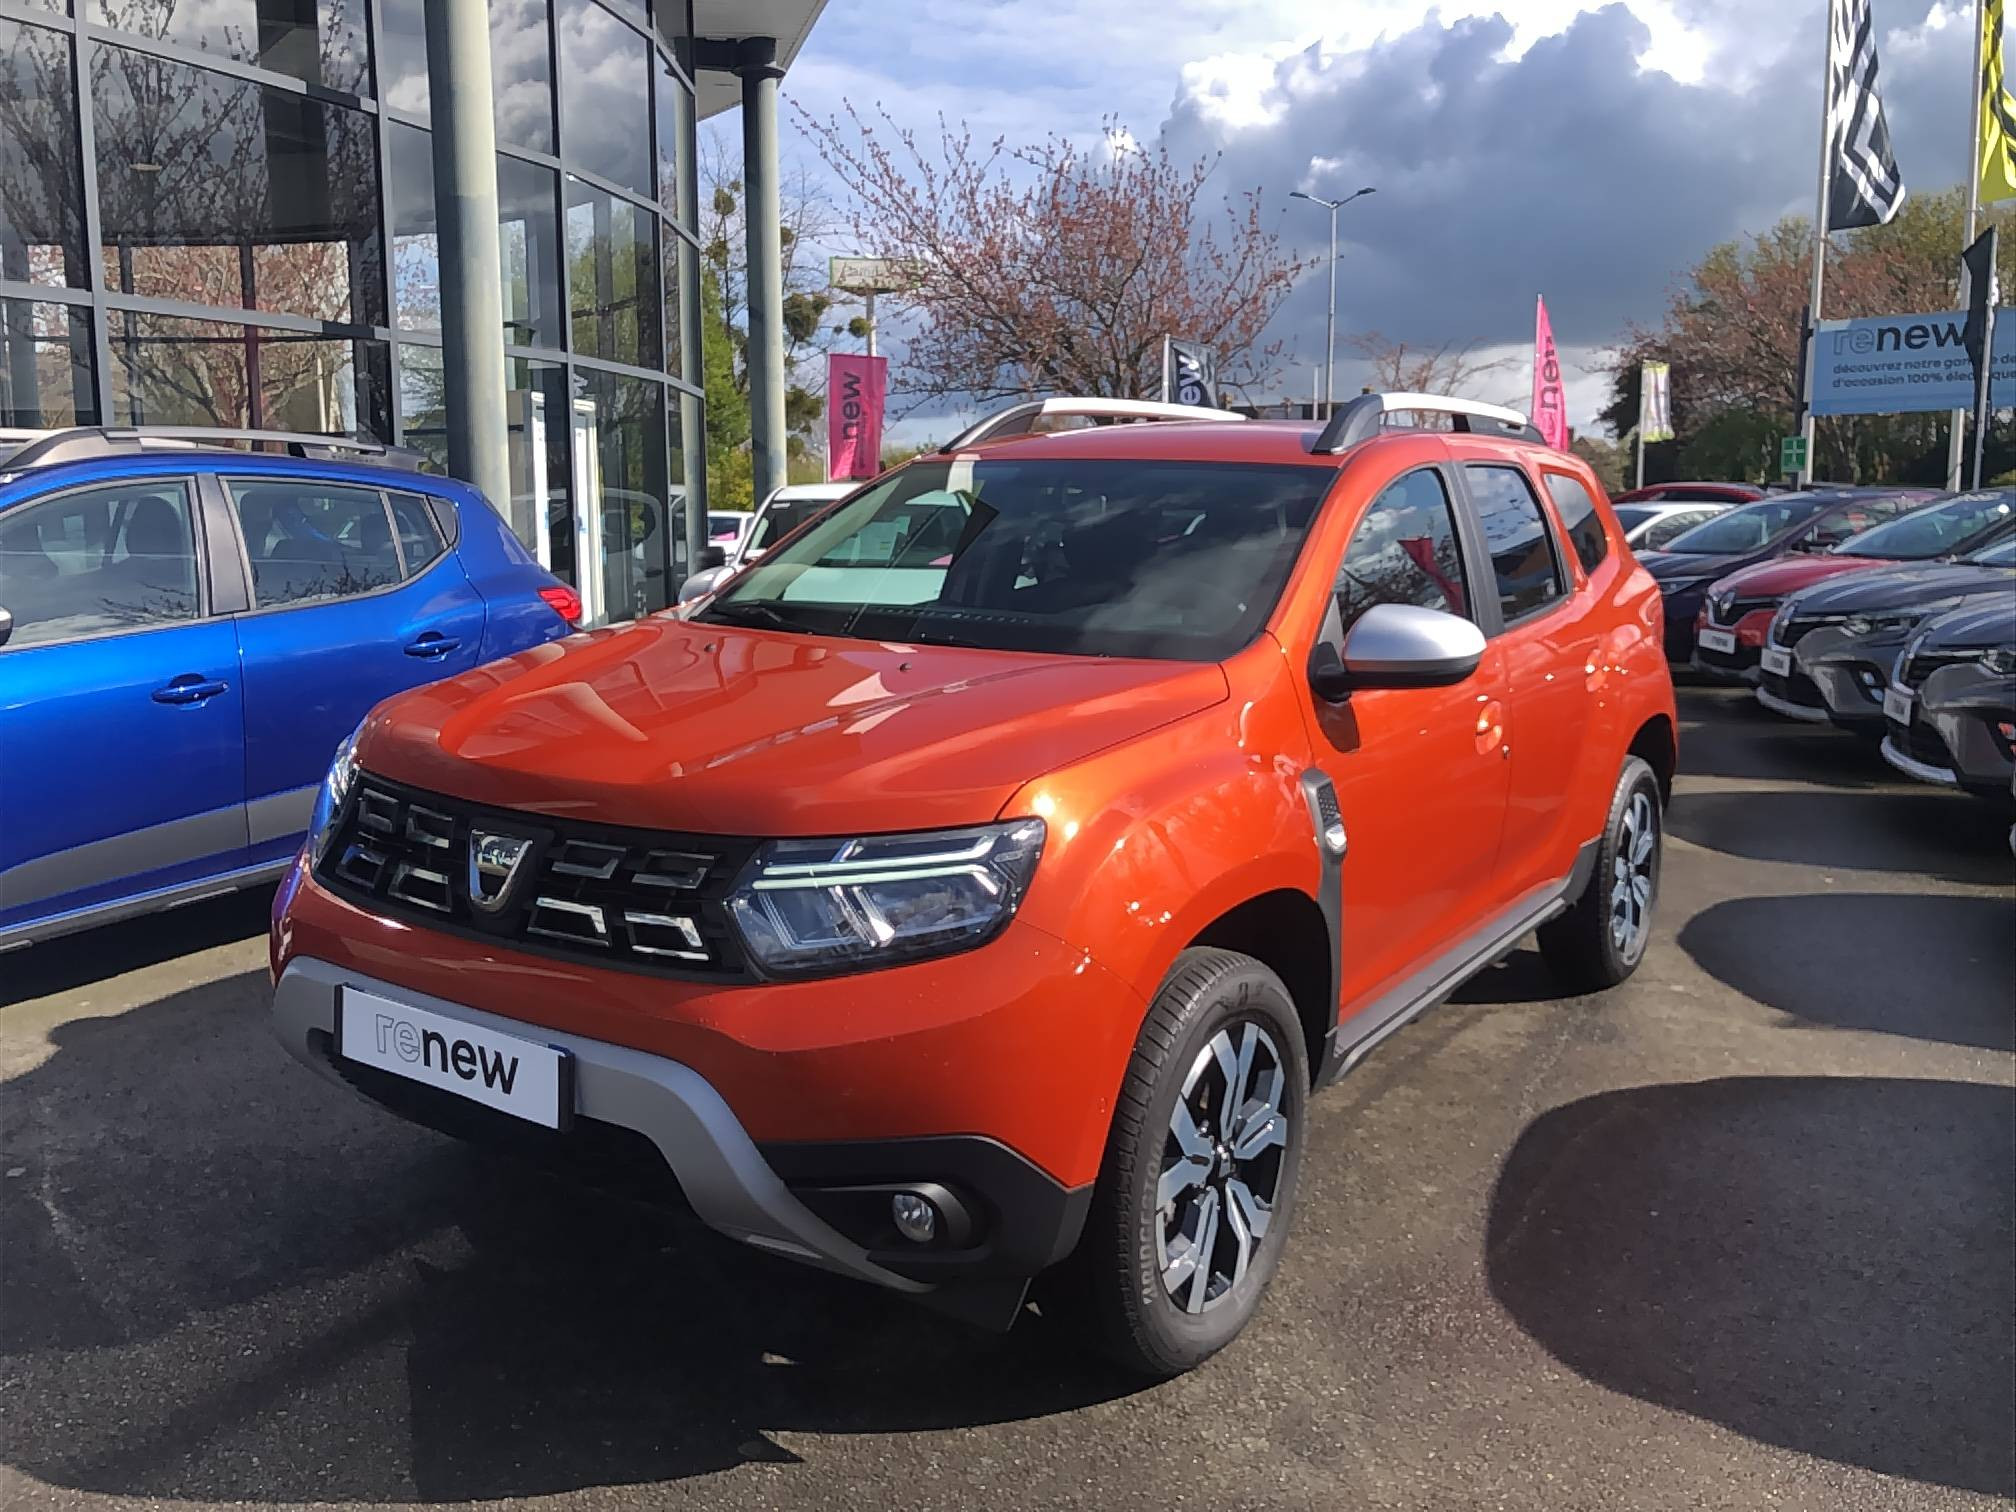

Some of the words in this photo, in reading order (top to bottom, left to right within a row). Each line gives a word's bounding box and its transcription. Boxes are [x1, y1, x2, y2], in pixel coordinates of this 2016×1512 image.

[1834, 323, 1966, 354] renew
[1833, 362, 1901, 374] découvrez
[1904, 359, 1941, 369] notre
[1832, 376, 1905, 388] d'occasion
[1907, 372, 1943, 384] 100%
[375, 1013, 519, 1095] renew
